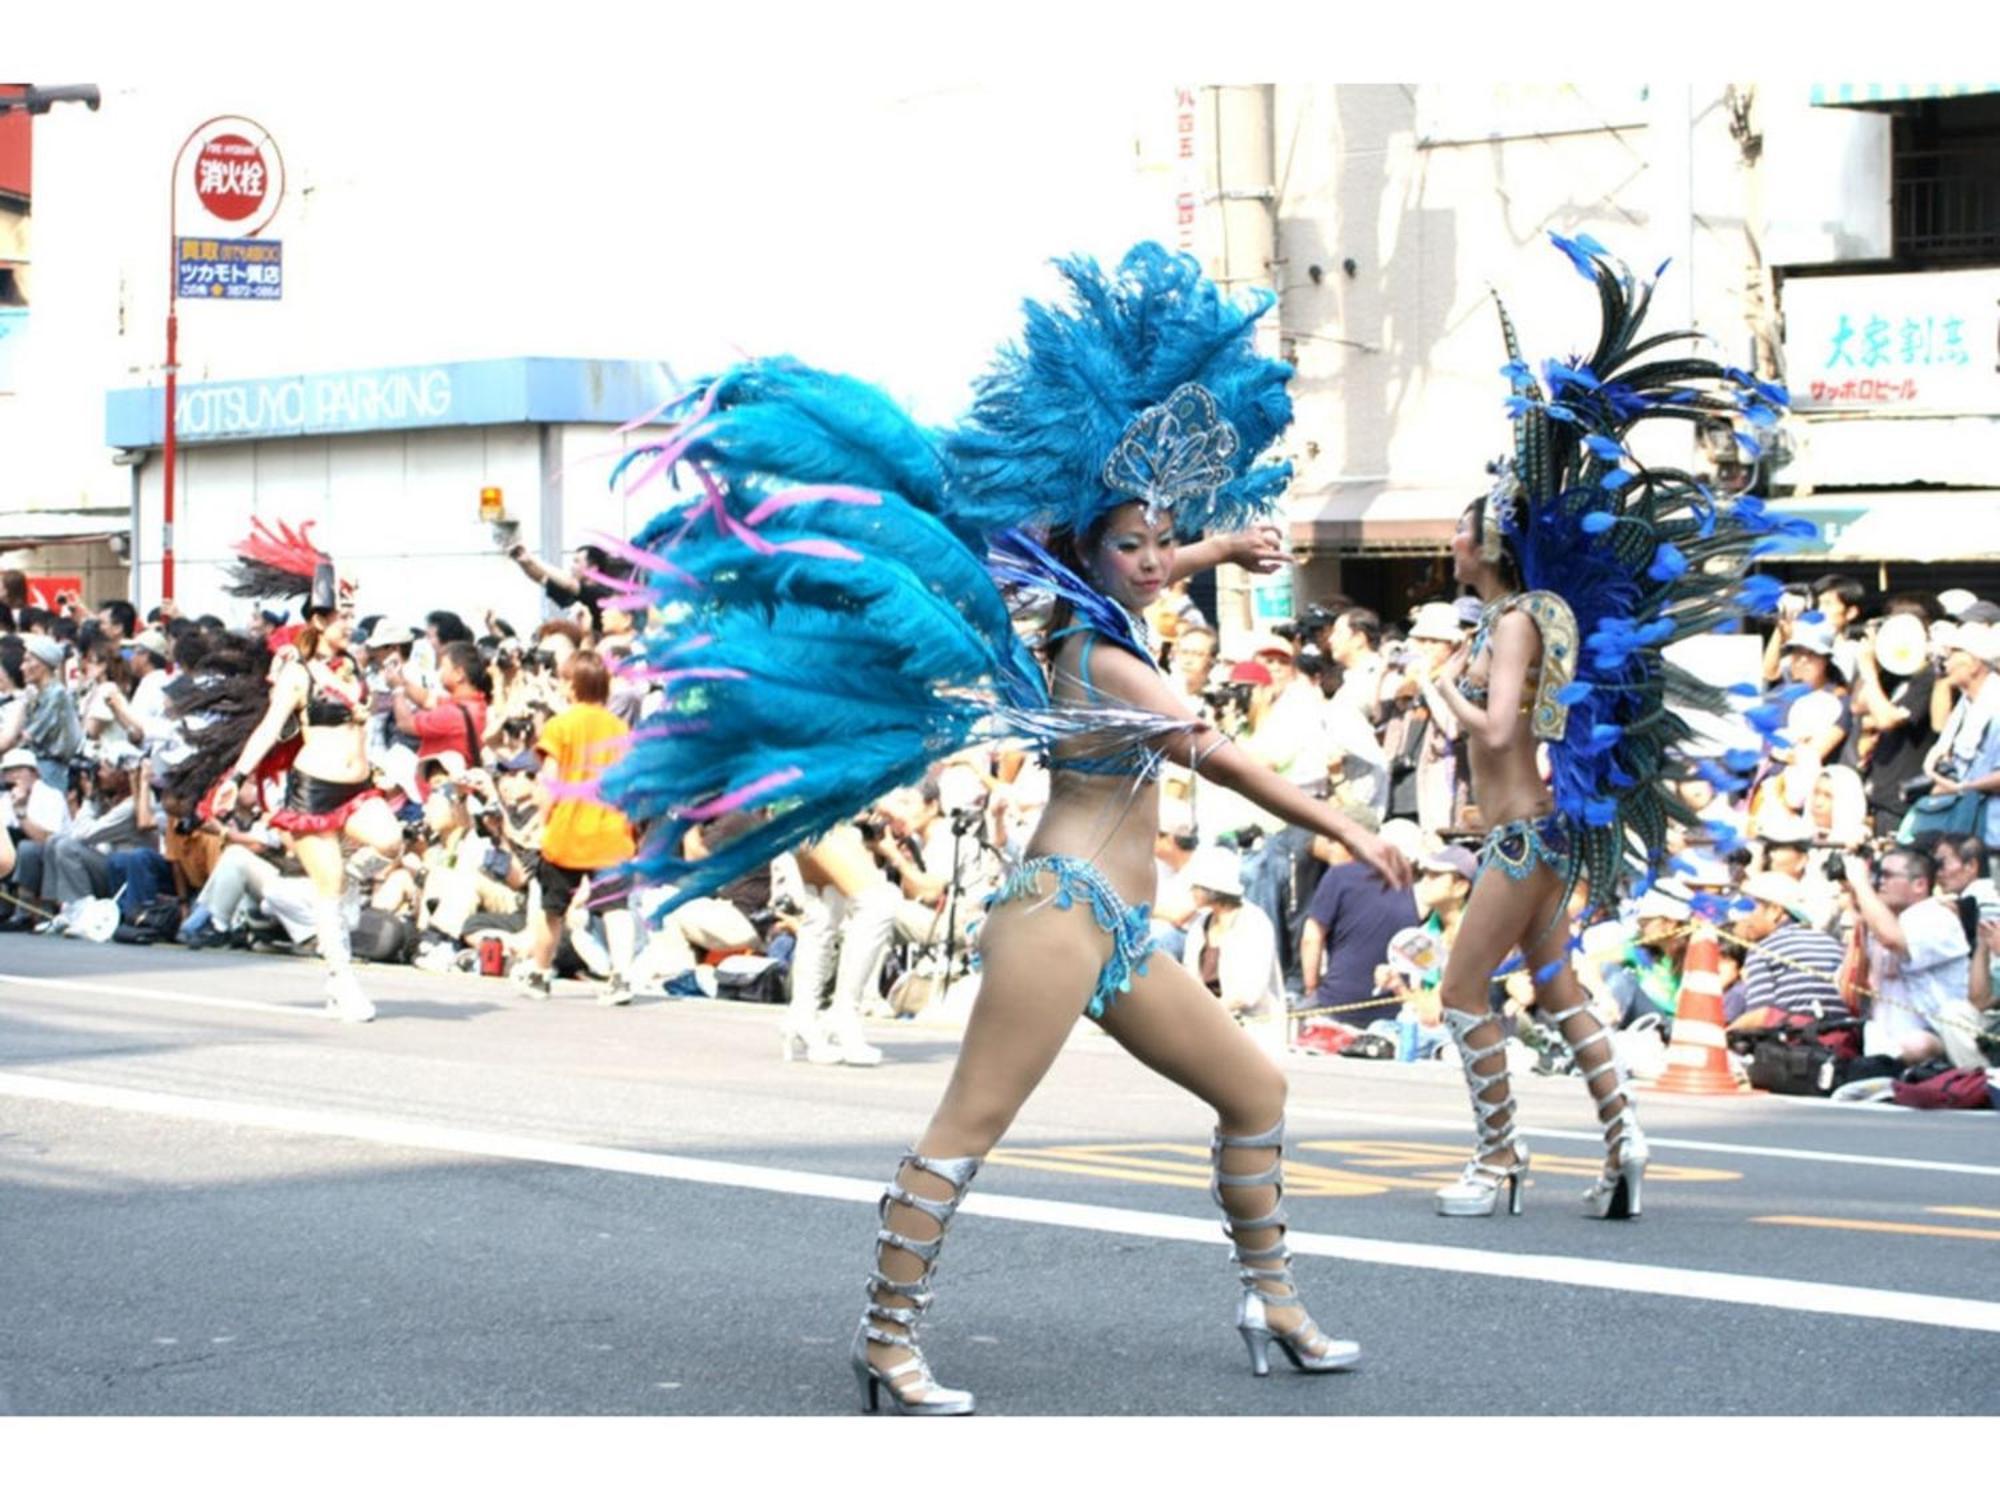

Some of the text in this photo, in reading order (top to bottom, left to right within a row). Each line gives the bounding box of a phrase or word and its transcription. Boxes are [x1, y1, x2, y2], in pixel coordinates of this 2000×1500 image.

[200, 159, 264, 197] 消火栓
[316, 368, 452, 424] PARKING
[1810, 378, 1919, 401] サッポロビール
